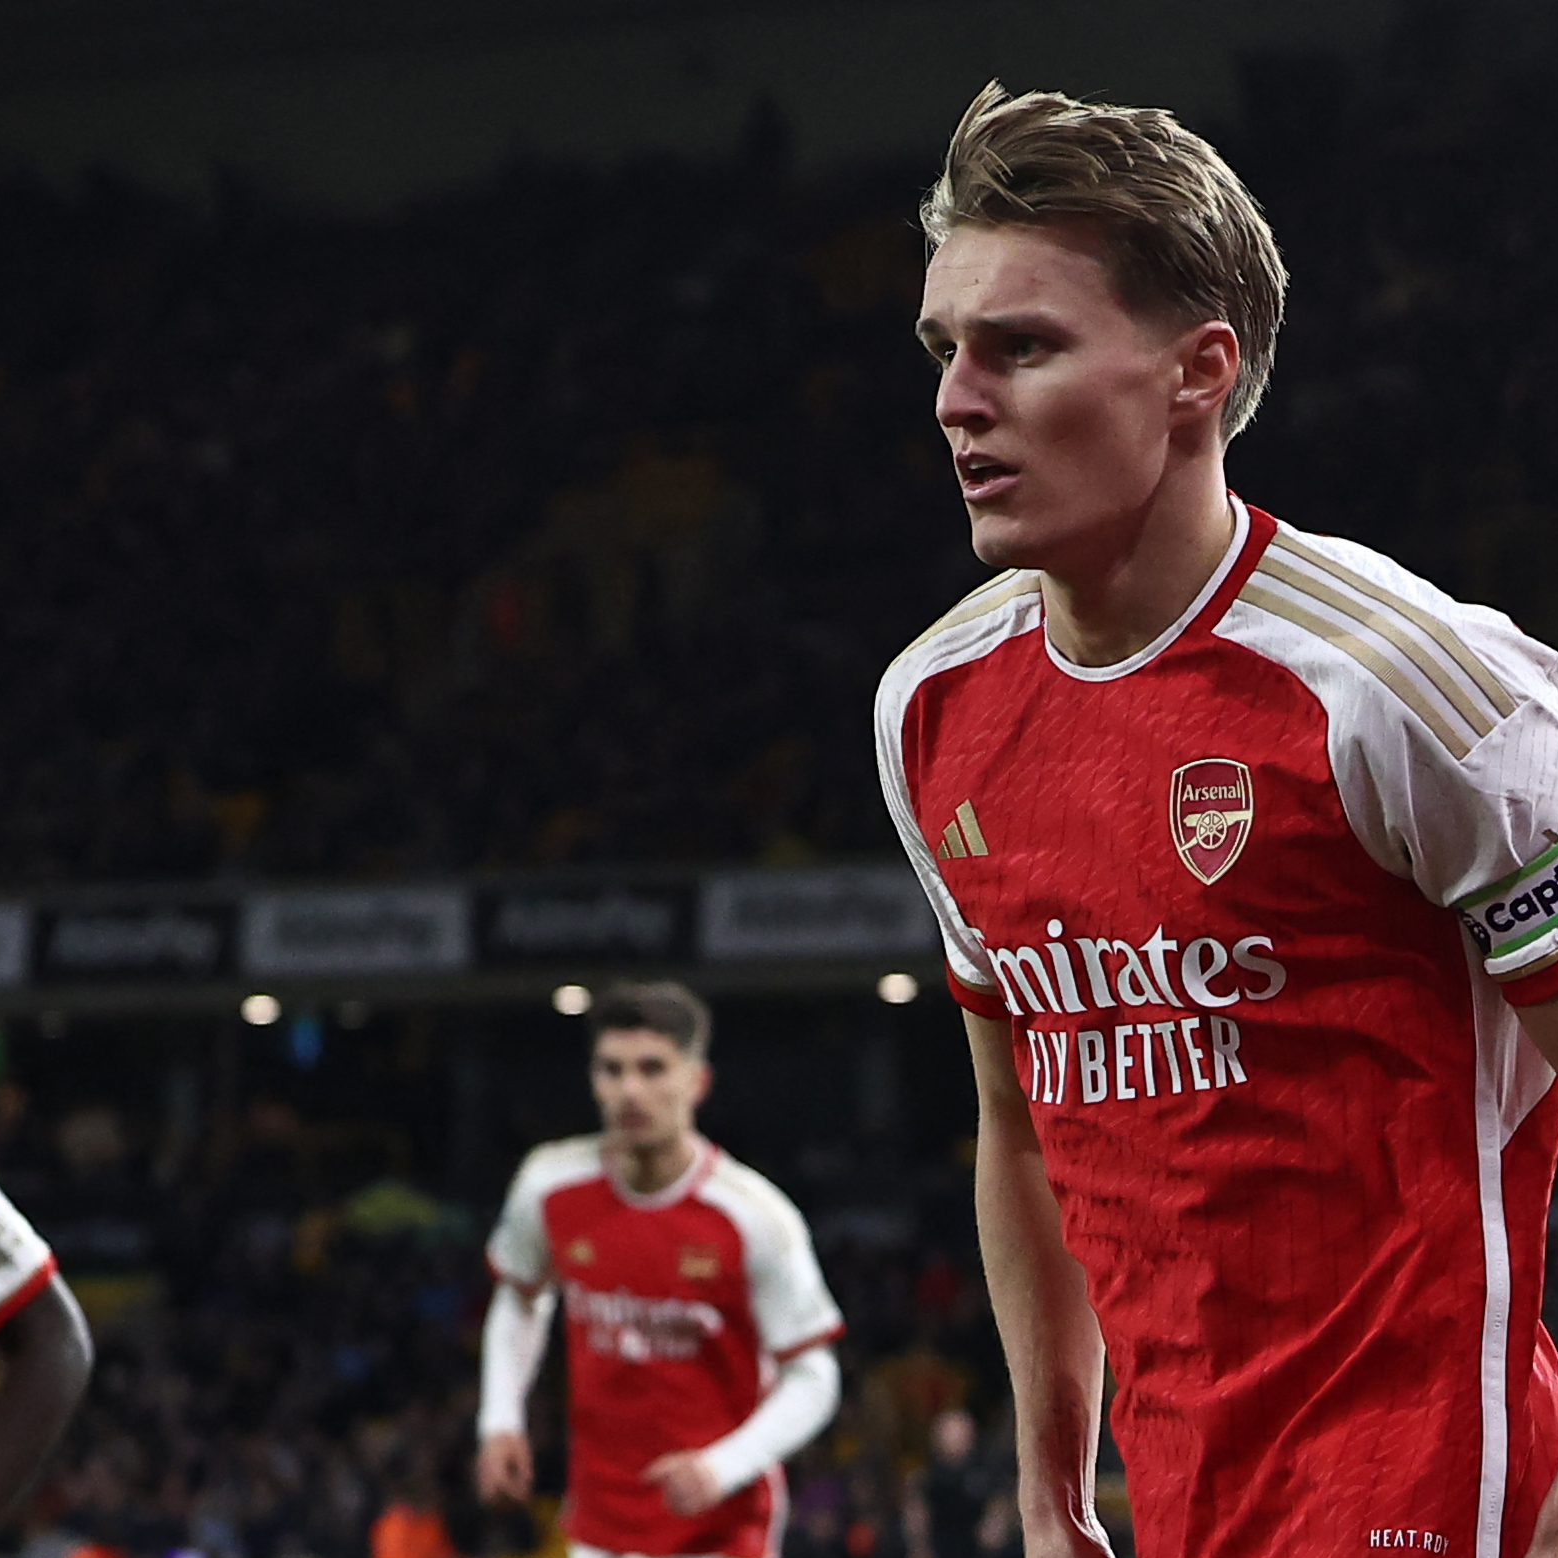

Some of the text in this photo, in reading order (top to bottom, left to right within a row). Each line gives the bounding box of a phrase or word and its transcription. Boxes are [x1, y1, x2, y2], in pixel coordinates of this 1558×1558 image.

[1182, 780, 1241, 802] Arsenal
[986, 918, 1287, 1016] mirates
[1027, 1014, 1248, 1105] FLY BETTER
[1369, 1529, 1450, 1556] HEAT.RDY
